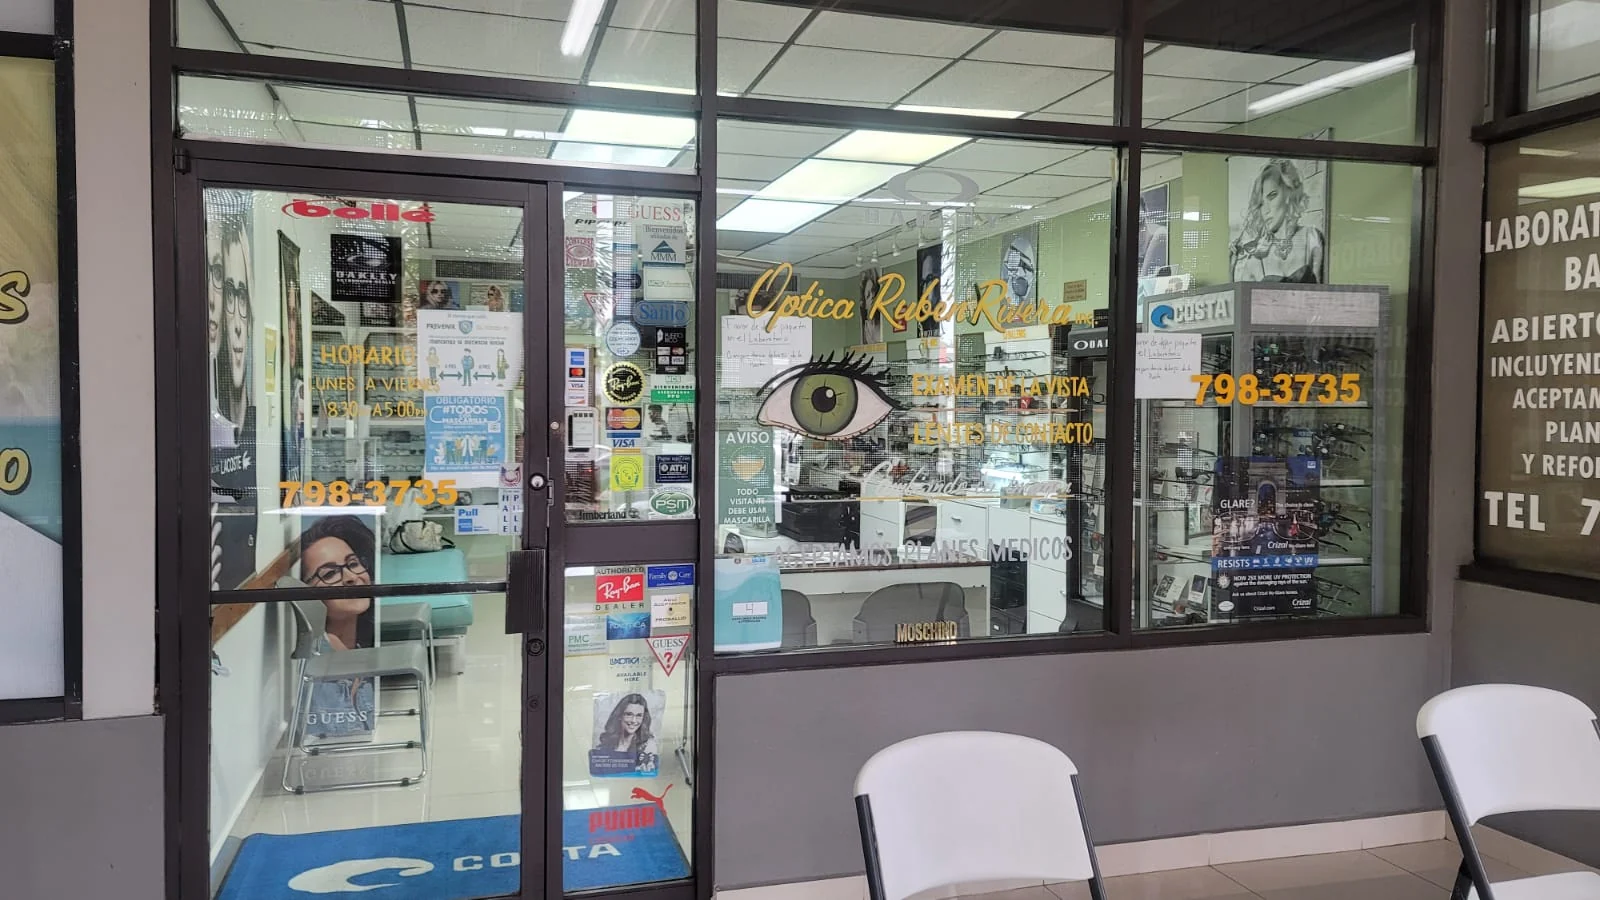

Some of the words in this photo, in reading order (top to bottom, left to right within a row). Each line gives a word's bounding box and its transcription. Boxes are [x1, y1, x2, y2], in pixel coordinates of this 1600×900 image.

[628, 204, 681, 221] GUESS
[651, 253, 676, 262] MMM
[1565, 253, 1600, 291] BA
[971, 278, 1074, 333] Rivera
[1174, 300, 1230, 323] COSTA
[1490, 311, 1600, 343] ABIERT
[321, 344, 415, 366] HORARIO
[309, 375, 356, 392] LUNES
[366, 377, 376, 391] A
[912, 372, 989, 397] EXAMEN
[994, 375, 1016, 396] DE
[1021, 375, 1043, 397] LA
[1045, 376, 1090, 398] VISTA
[1190, 373, 1362, 406] 798-3735
[436, 396, 496, 404] OBLIGATORIO
[372, 402, 383, 417] A
[442, 405, 489, 414] #TODOS
[726, 432, 770, 445] AVISO
[914, 422, 984, 445] LENTES
[991, 422, 1012, 444] DE
[1015, 421, 1093, 443] CONTACTO
[1545, 421, 1600, 443] PLAN
[612, 439, 635, 447] VISA
[220, 455, 242, 474] LACOSTE
[669, 464, 686, 472] ATH
[1522, 453, 1535, 474] Y
[277, 479, 458, 509] 798-3735
[736, 488, 760, 497] TODO
[655, 499, 689, 510] PSM
[729, 497, 765, 506] VISITANTE
[1220, 499, 1256, 509] GLARE?
[727, 507, 746, 515] DEBE
[748, 507, 767, 515] USAR
[1484, 491, 1546, 532] TEL
[1580, 497, 1600, 536] 7
[723, 516, 771, 525] MASCARILLA
[903, 539, 977, 565] PLANES
[988, 536, 1073, 563] MEDICOS
[1267, 541, 1288, 549] Crizal
[596, 567, 644, 575] AUTHORIZED
[1217, 559, 1250, 569] RESISTS
[598, 576, 641, 599] Ray-Ban
[596, 603, 644, 611] DEALER
[745, 603, 753, 614] 4
[1292, 598, 1311, 606] Crizal
[568, 635, 589, 643] PMC
[897, 621, 958, 643] MOSCHINO
[653, 639, 684, 648] GUESS
[307, 710, 369, 725] GUESS
[589, 805, 656, 833] PUMA
[453, 842, 623, 872] COTA
